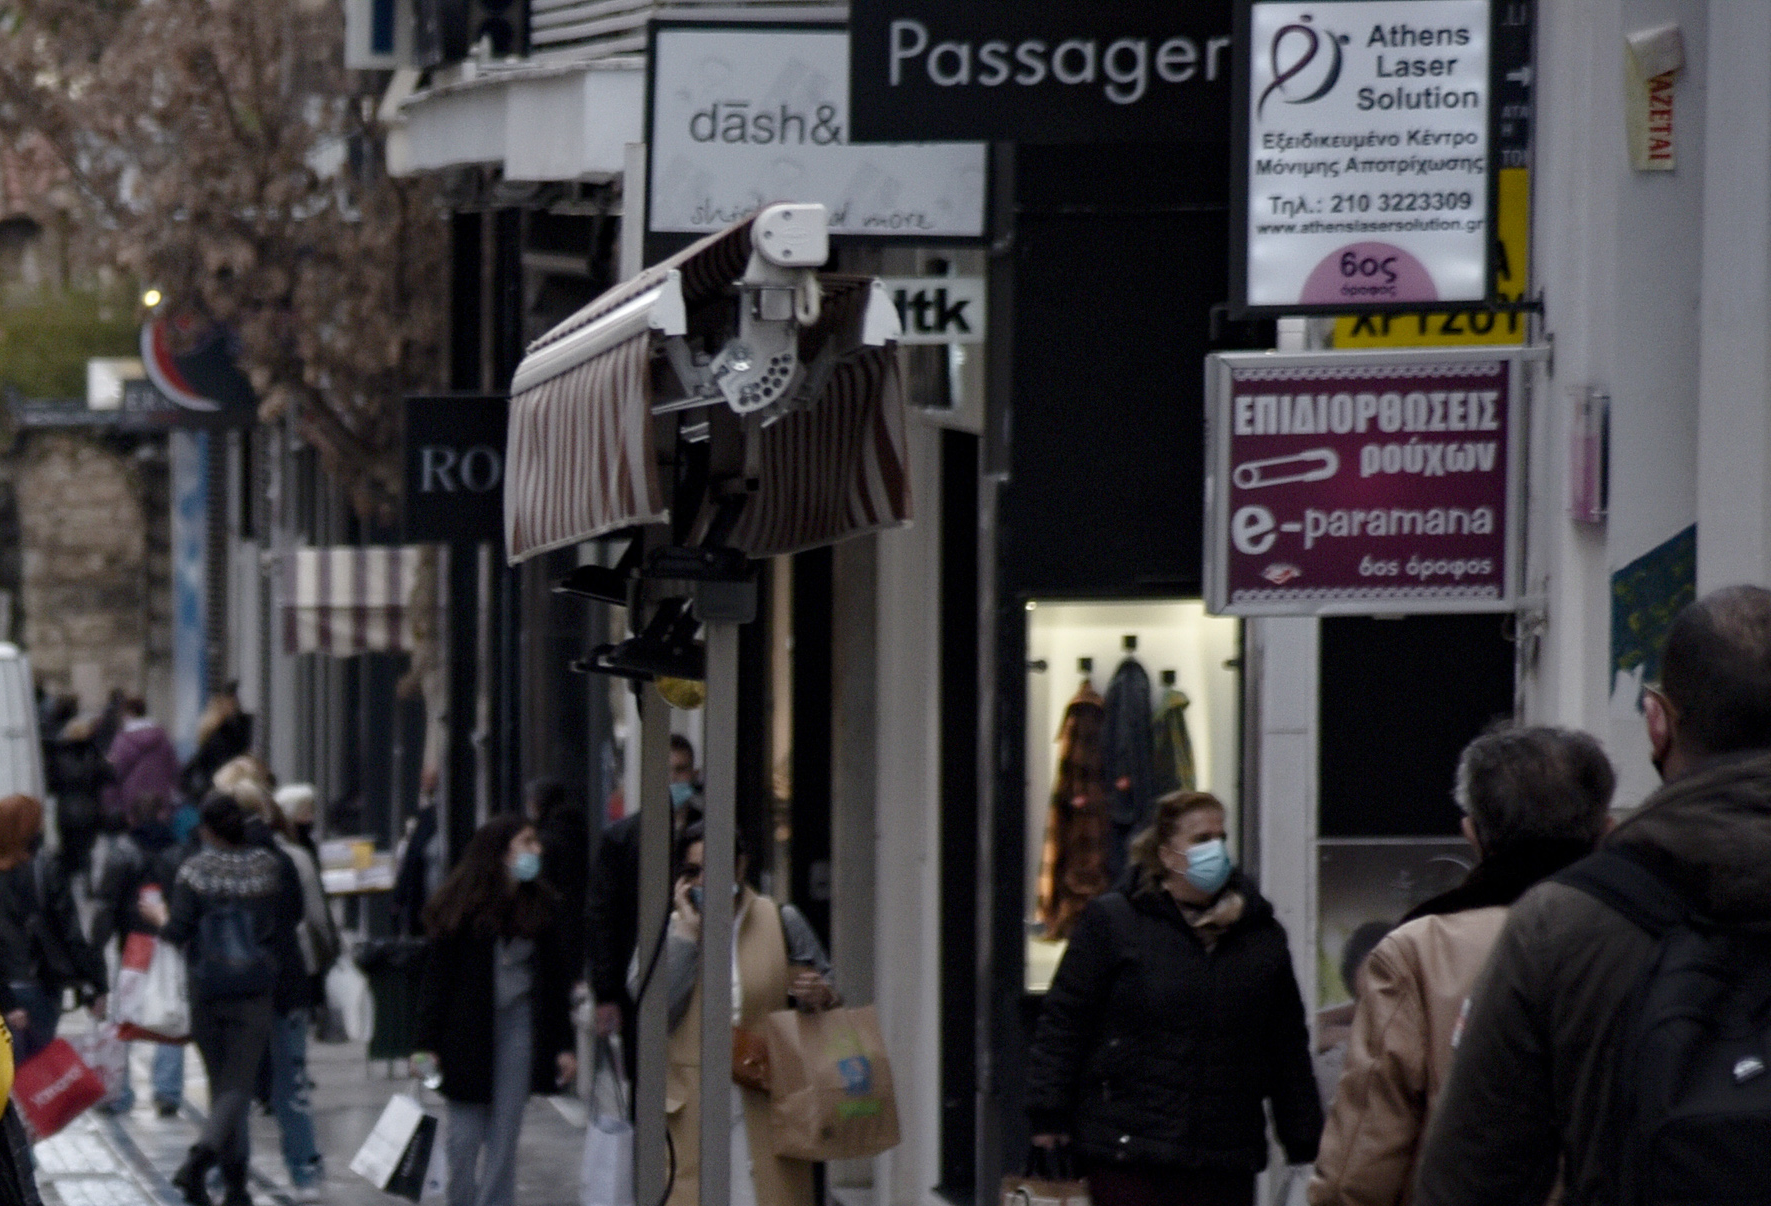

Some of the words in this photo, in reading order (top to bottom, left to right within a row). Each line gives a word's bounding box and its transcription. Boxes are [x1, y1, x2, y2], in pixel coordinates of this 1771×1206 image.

[1366, 24, 1470, 47] Athens
[889, 18, 1231, 105] Passager
[1376, 55, 1458, 78] Laser
[1356, 86, 1479, 111] Solution
[1262, 131, 1401, 152] Εξειδικευμένο
[1406, 129, 1479, 148] Κέντρο
[1255, 158, 1340, 177] Μόνιμης
[1344, 155, 1485, 177] Αποτρίχωσης
[1331, 195, 1370, 213] 210
[1378, 192, 1472, 212] 3223309
[1256, 218, 1486, 236] www.athenslasersolution.gr
[1341, 252, 1398, 284] 6ος
[1234, 391, 1499, 436] ΕΠΙΔΙΟΡΘΩΣΕΙΣ
[1360, 437, 1497, 478] ρούχων
[1231, 504, 1494, 556] e-paramana
